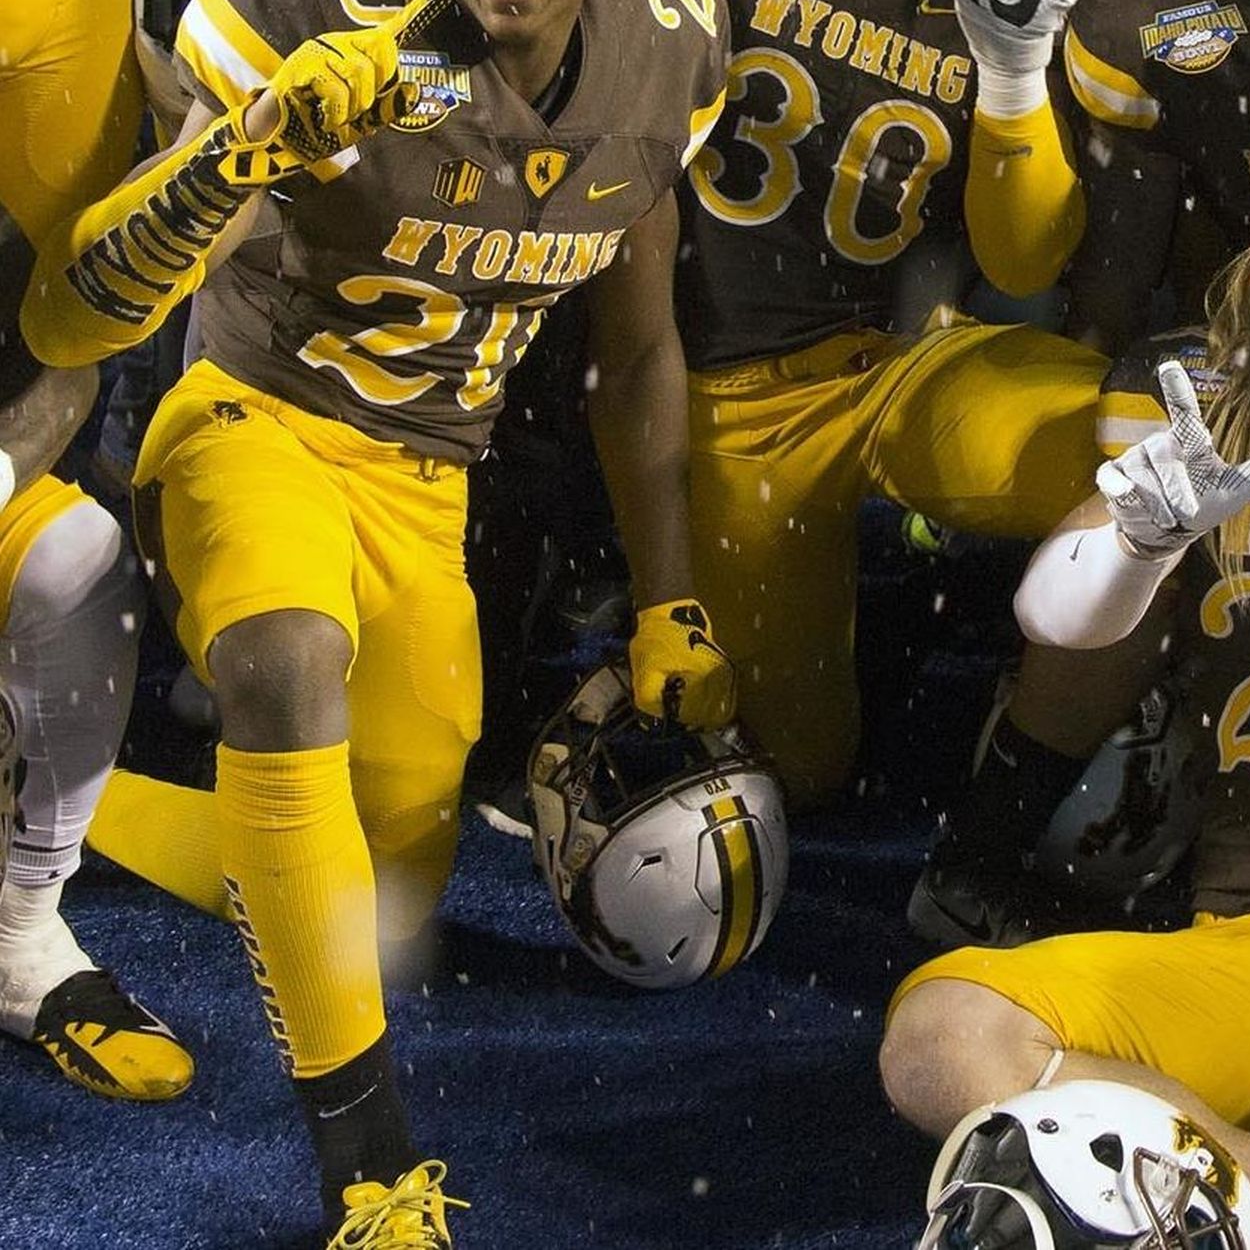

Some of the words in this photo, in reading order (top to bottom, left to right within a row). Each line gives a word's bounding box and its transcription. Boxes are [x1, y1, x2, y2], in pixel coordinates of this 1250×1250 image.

[1162, 4, 1213, 23] FAMOUS
[399, 53, 443, 66] AMOUS
[689, 48, 952, 265] 30
[382, 216, 627, 285] WYOMING
